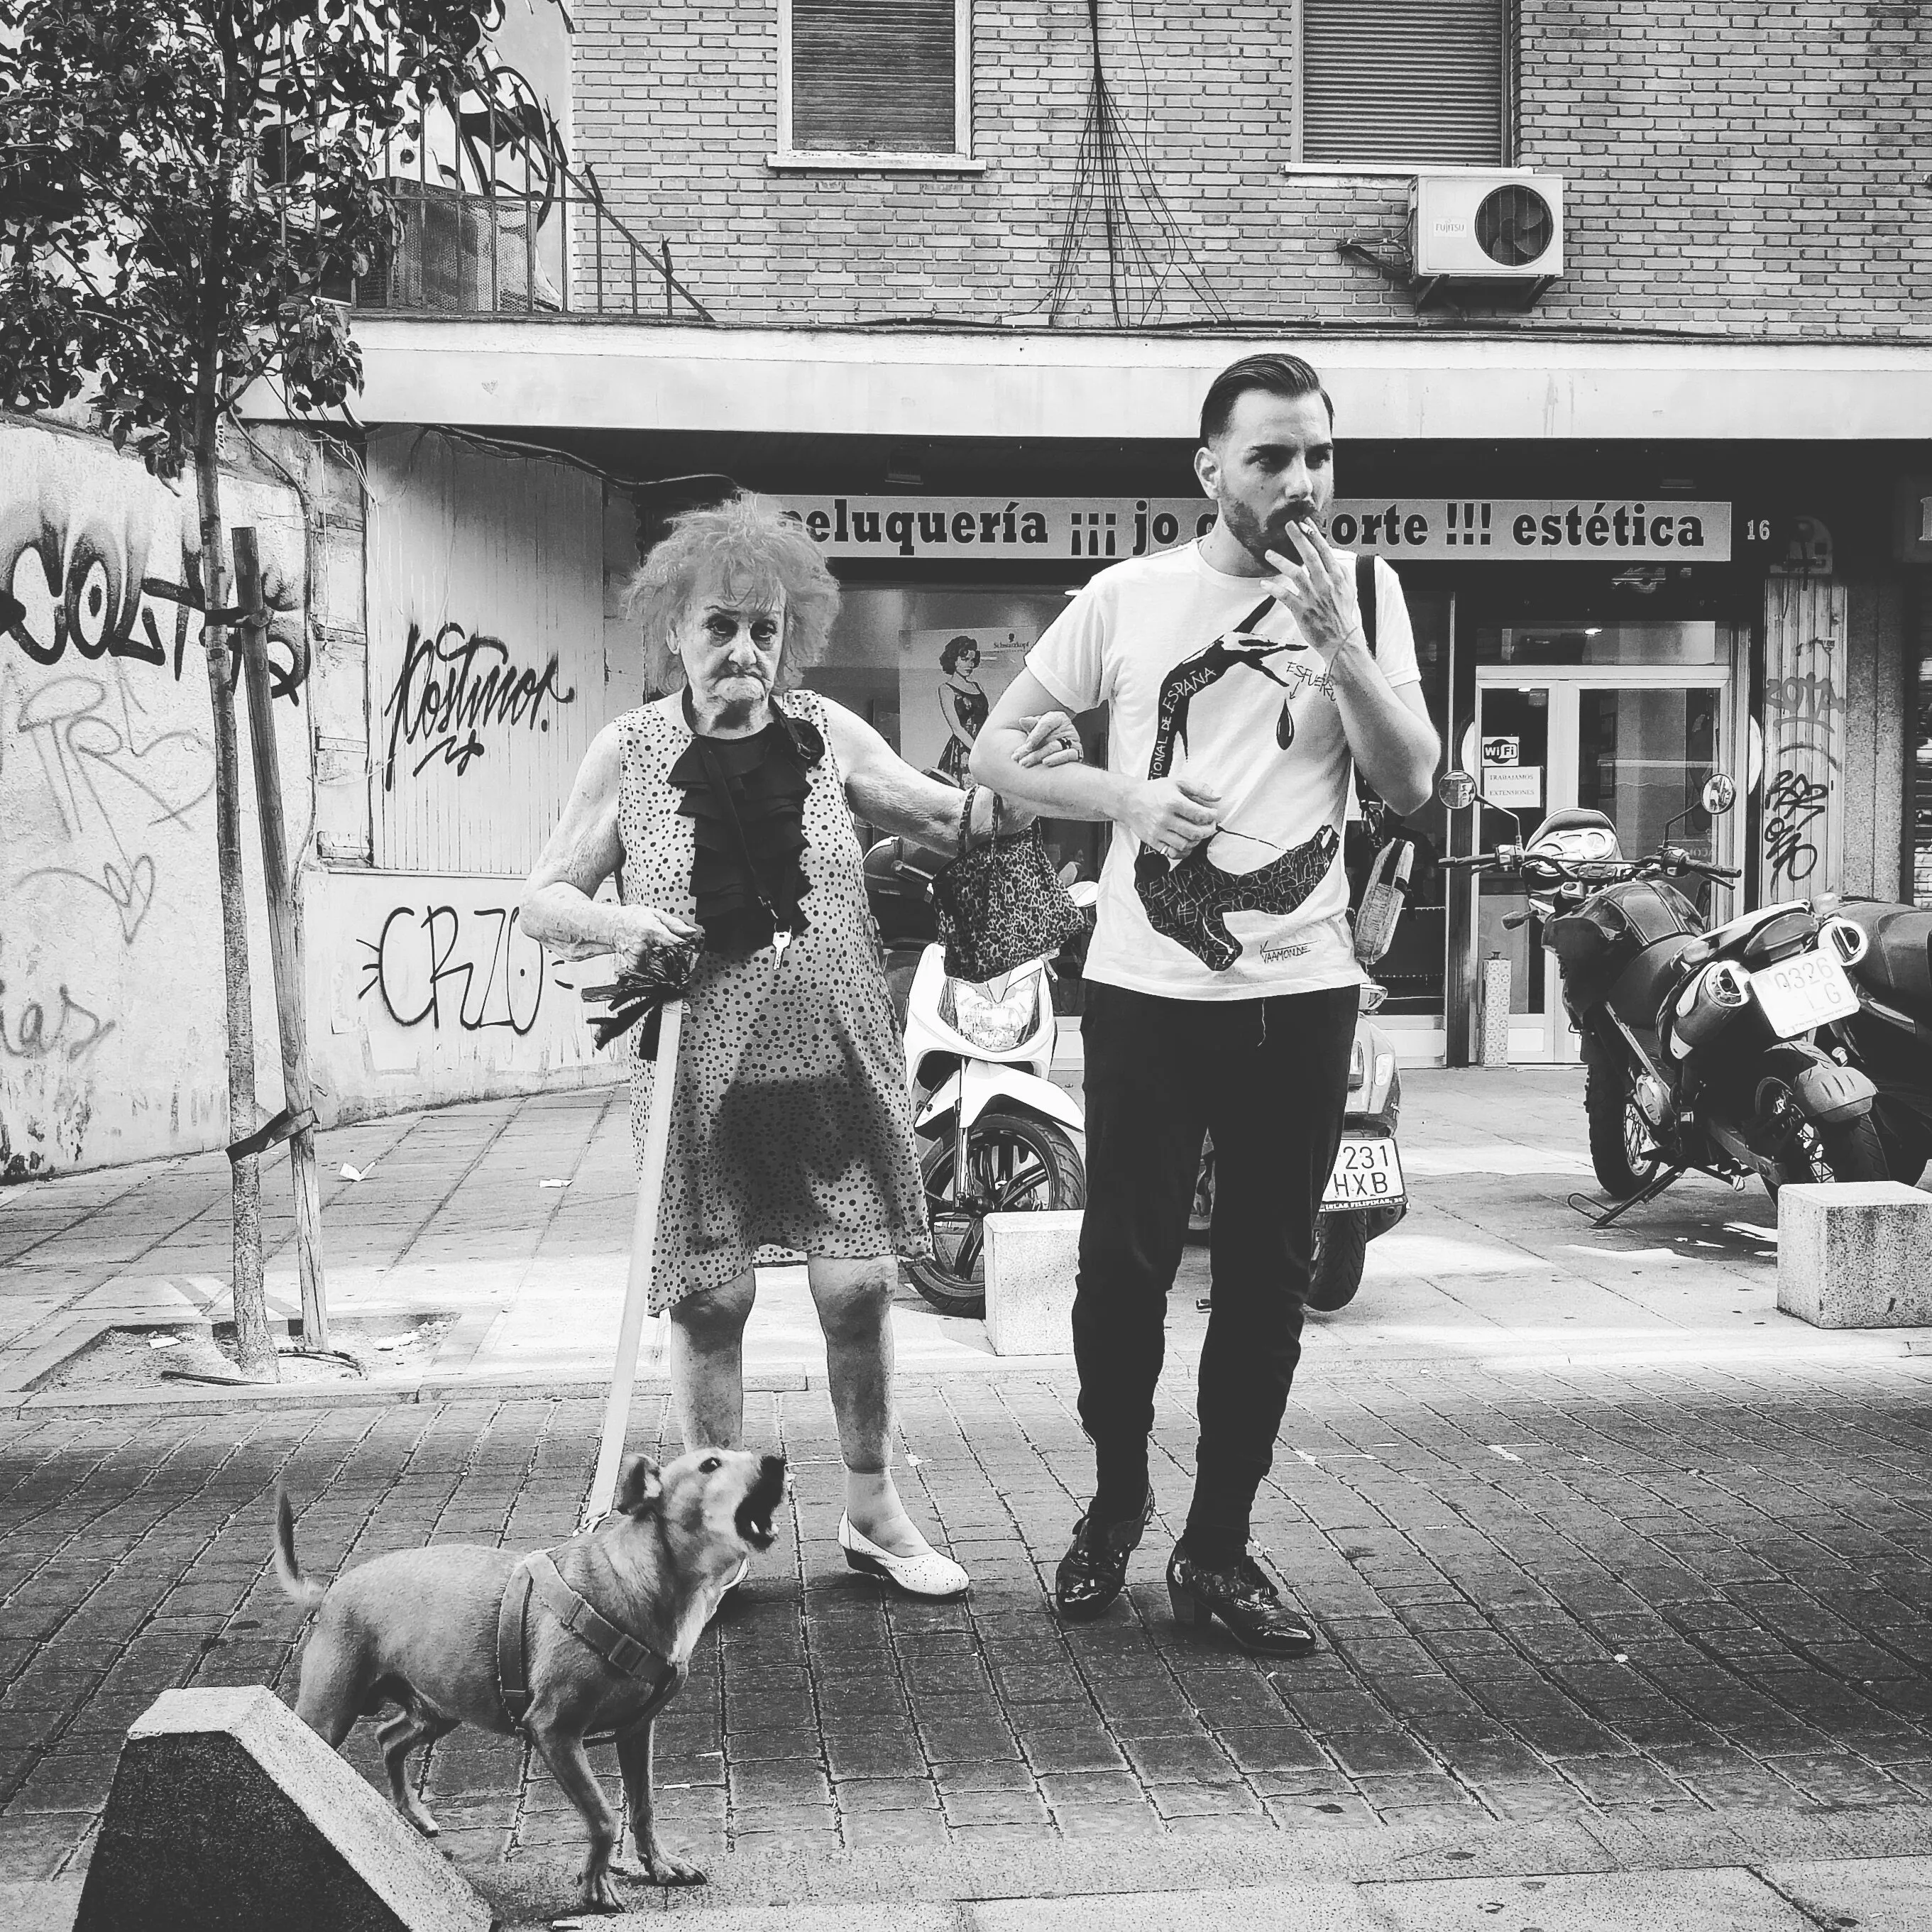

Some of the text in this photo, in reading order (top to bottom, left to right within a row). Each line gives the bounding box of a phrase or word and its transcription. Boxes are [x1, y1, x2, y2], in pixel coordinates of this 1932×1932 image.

[1436, 223, 1464, 233] FUJITSU
[1133, 500, 1179, 556] jo
[1322, 503, 1428, 546] orte
[1513, 503, 1704, 547] estética
[1747, 520, 1770, 540] 16
[1150, 736, 1168, 780] IONAL
[1162, 667, 1217, 713] ESPAÑA
[1261, 946, 1312, 964] VAAMONDE
[1343, 1145, 1388, 1170] 231
[1334, 1172, 1388, 1197] HXB
